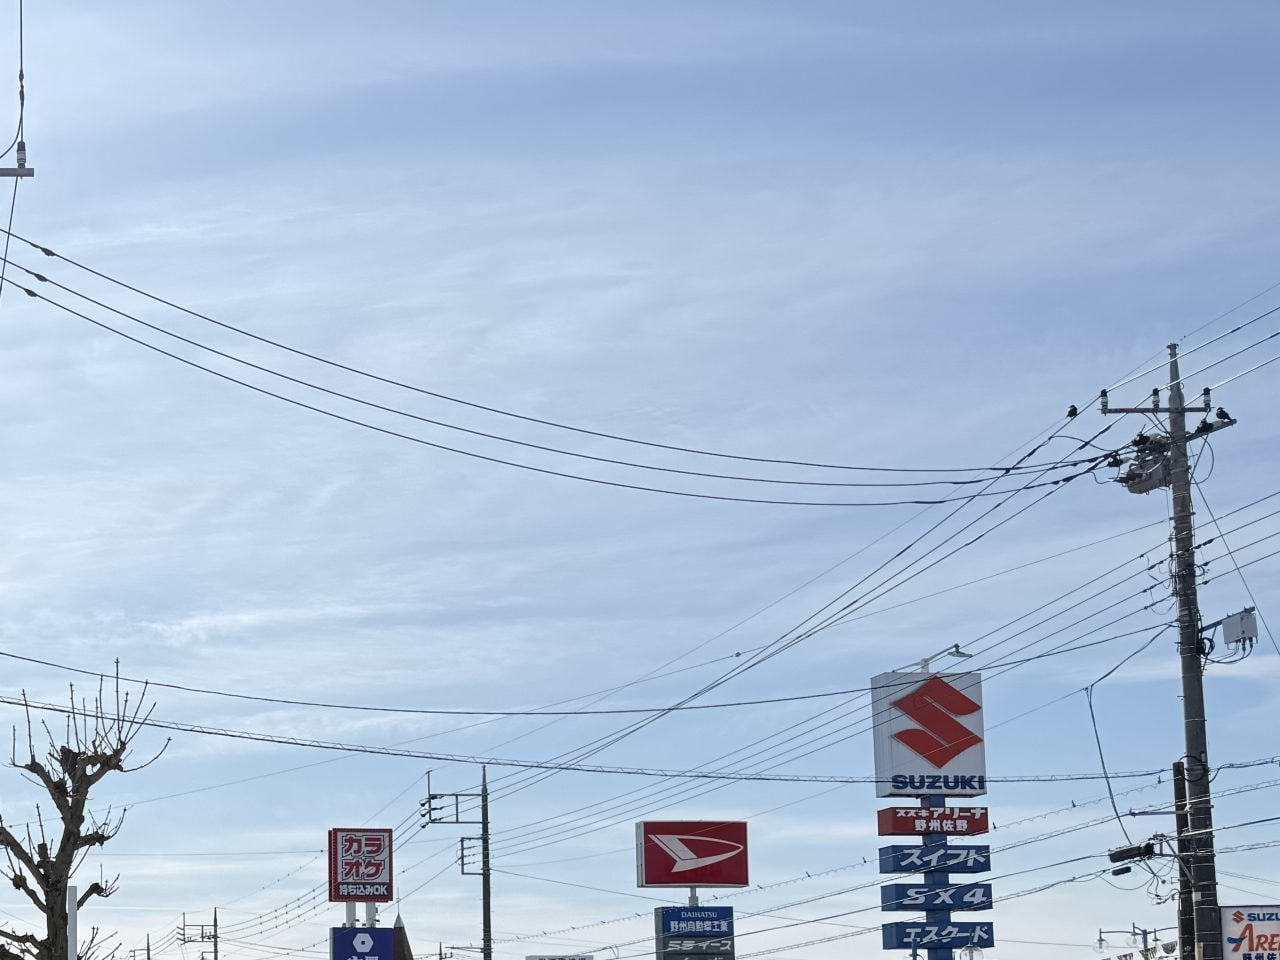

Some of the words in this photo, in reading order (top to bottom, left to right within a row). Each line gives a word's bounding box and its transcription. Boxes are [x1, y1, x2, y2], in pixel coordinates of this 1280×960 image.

[892, 775, 985, 790] SUZUKI
[896, 807, 986, 820] スズキアリーナ
[914, 819, 968, 832] 野州佐野
[342, 834, 385, 857] カラ
[900, 848, 987, 867] スイフト
[342, 857, 385, 881] オケ
[339, 884, 388, 895] 持ち込みOK
[670, 921, 728, 932] 野州自動車工業
[903, 925, 989, 943] エスクード
[1227, 923, 1280, 952] ARE
